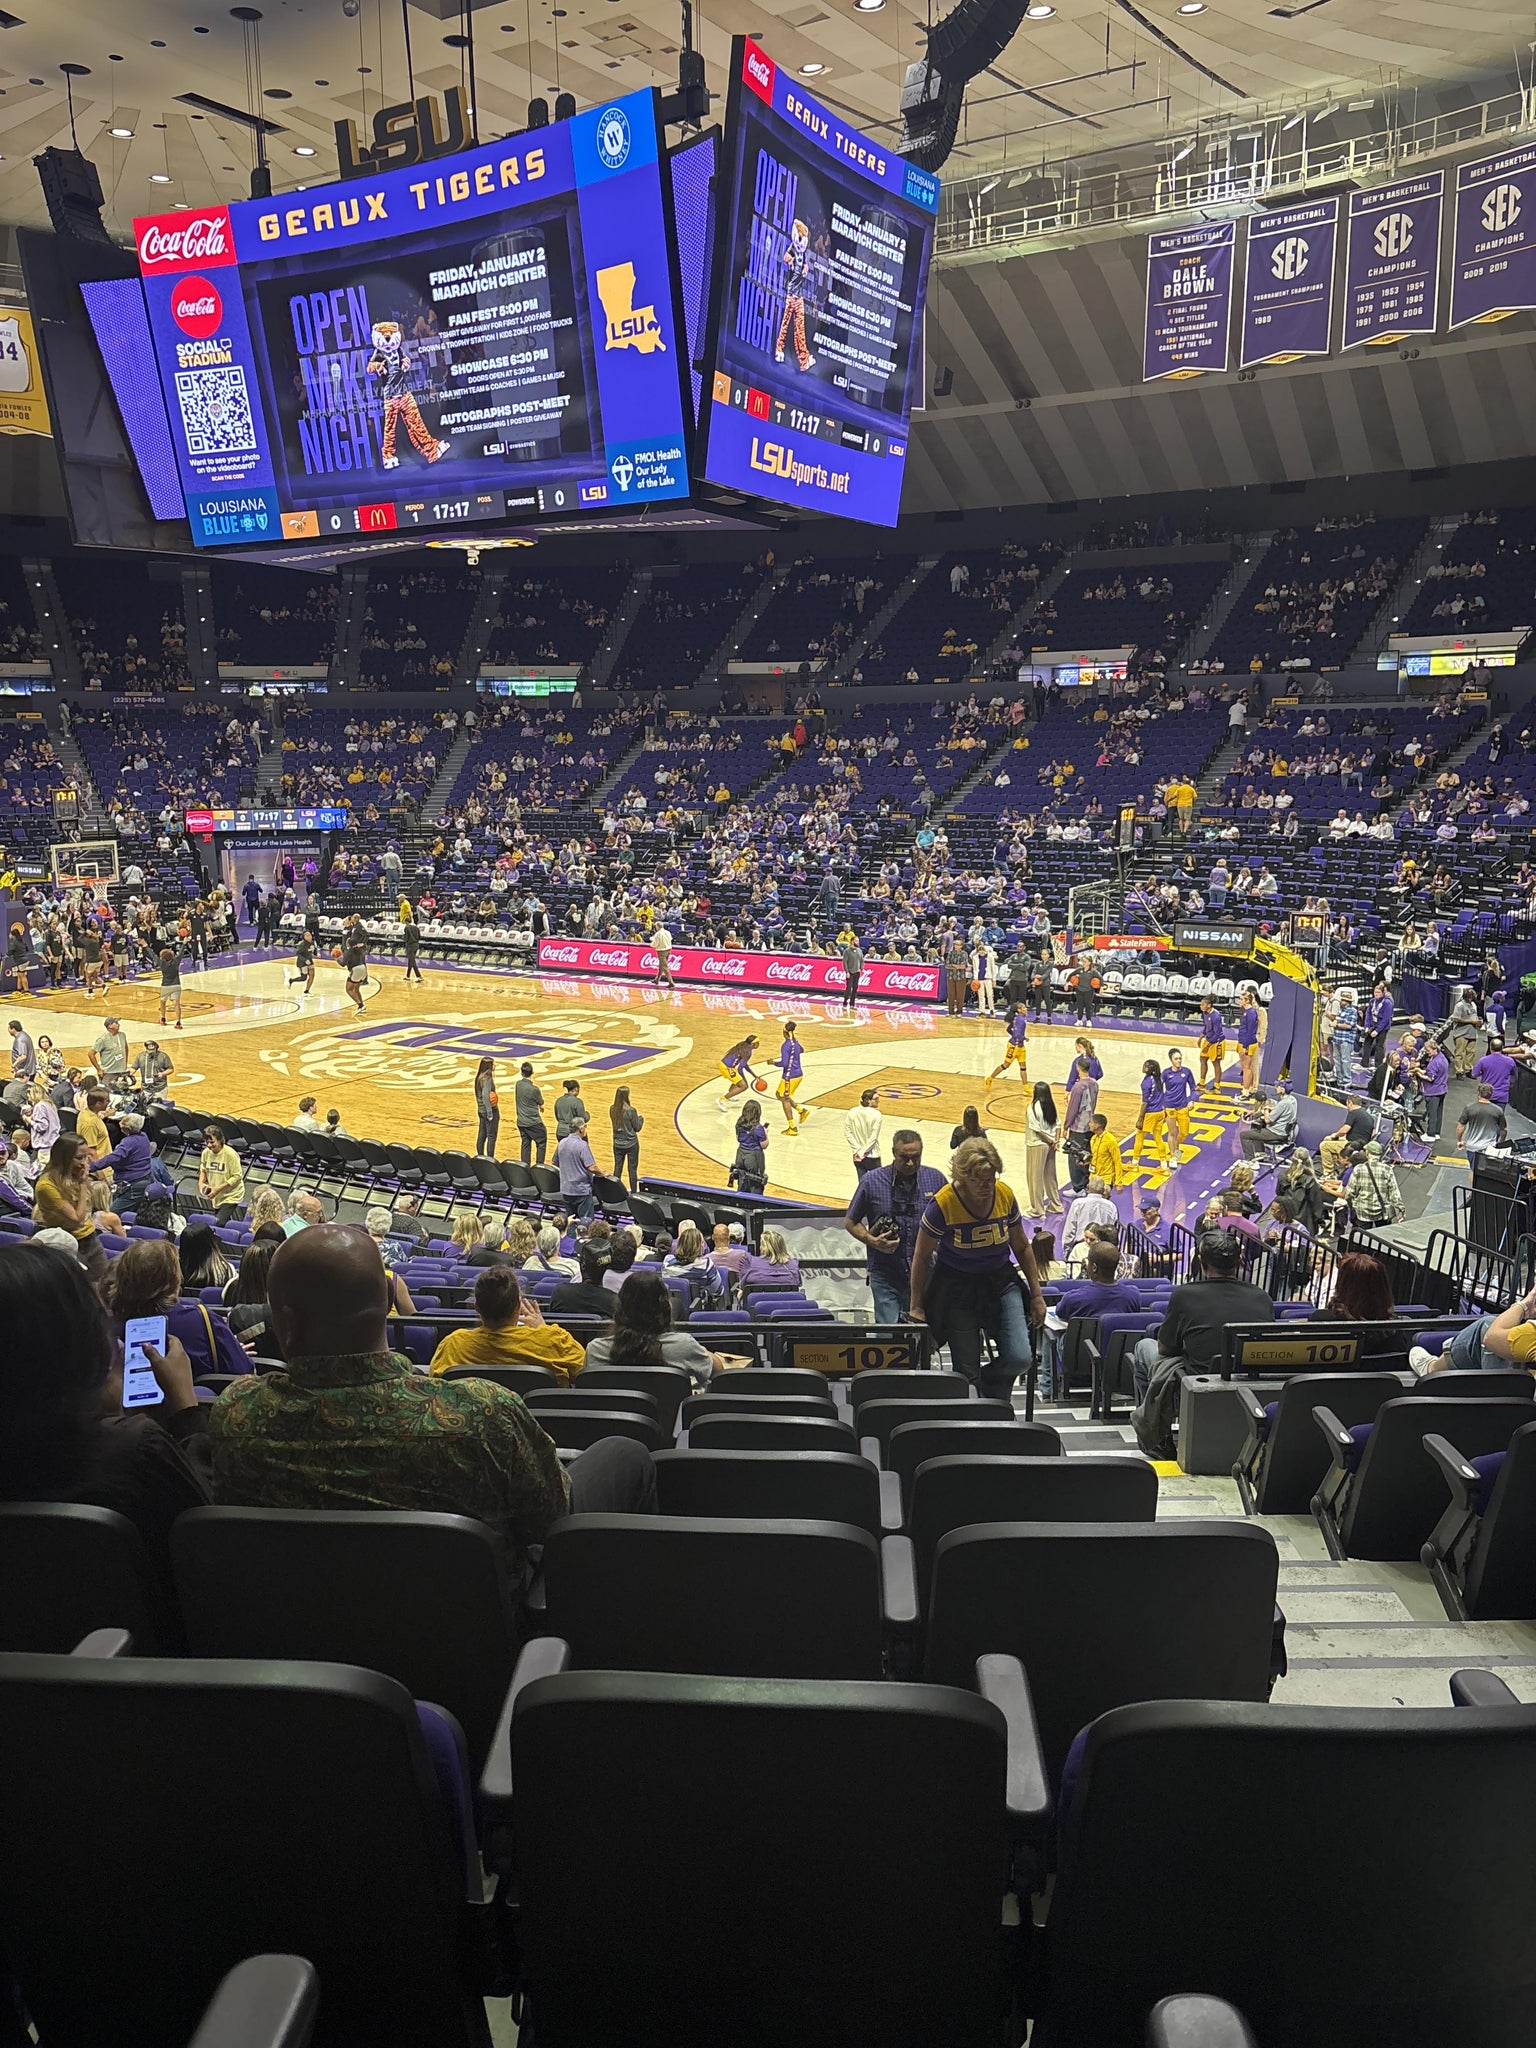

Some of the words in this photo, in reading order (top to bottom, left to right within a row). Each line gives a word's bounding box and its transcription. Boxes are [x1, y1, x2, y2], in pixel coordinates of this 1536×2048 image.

[334, 85, 472, 180] LSU
[599, 111, 626, 138] HANCOCK
[786, 94, 828, 140] GEAUX
[835, 131, 886, 176] TIGERS
[601, 138, 628, 168] WHITNEY
[1470, 166, 1492, 178] MEN'S
[1495, 151, 1536, 170] BASKETBAL
[907, 170, 935, 191] LOUISIANA
[258, 192, 388, 241] GEAUX
[409, 148, 546, 210] TIGERS
[754, 148, 798, 234] OPEN
[906, 183, 921, 199] BLUE
[1362, 193, 1384, 205] MEN'S
[1386, 182, 1430, 199] BASKETBALL
[1481, 184, 1522, 231] SEC
[1261, 218, 1281, 228] MEN'S
[1284, 208, 1325, 223] BASKETBALL
[141, 217, 228, 264] Coca-Cola
[1161, 237, 1181, 247] MEN'S
[1183, 231, 1223, 244] BASKETBALL
[1374, 213, 1414, 257] SEC
[1475, 232, 1524, 253] CHAMPIONS
[429, 264, 478, 286] FRIDAY,
[479, 250, 535, 275] JANUARY
[537, 247, 545, 261] 2
[1180, 256, 1201, 265] COACH
[1271, 237, 1309, 280] SEC
[1173, 265, 1207, 283] DALE
[1368, 259, 1416, 277] CHAMPIONS
[1464, 268, 1483, 279] 2009
[1490, 261, 1508, 273] 2019
[433, 276, 498, 301] MARAVICH
[499, 265, 546, 287] CENTER
[1164, 278, 1214, 299] BROWN
[1357, 292, 1374, 302] 1935
[1382, 286, 1399, 297] 1953
[1407, 281, 1424, 291] 1954
[1254, 290, 1289, 301] TOURNAMENT
[1291, 284, 1323, 294] CHAMPIONS
[177, 297, 215, 317] Coca-Cola
[449, 314, 470, 327] FAN
[472, 308, 498, 322] FEST
[500, 303, 523, 316] 5:00
[524, 299, 538, 312] PM
[1190, 304, 1207, 312] FOURS
[1357, 305, 1373, 315] 1979
[289, 285, 374, 354] OPEN
[439, 330, 460, 339] TSHIRT
[461, 323, 490, 336] GIVEAWAY
[491, 321, 502, 330] FOR
[503, 319, 519, 328] FIRST
[520, 315, 535, 326] 1,000
[536, 311, 551, 321] FANS
[1186, 314, 1204, 322] TITLES
[1379, 311, 1399, 322] 2000
[418, 343, 440, 353] CROWN
[447, 338, 470, 349] TROPHY
[470, 332, 495, 344] STATION
[500, 329, 513, 339] KIDS
[514, 326, 529, 337] ZONE
[533, 323, 549, 333] FOOD
[550, 317, 573, 329] TRUCKS
[611, 316, 647, 340] LSU
[1178, 321, 1218, 332] TOURNAMENTS
[1179, 333, 1205, 342] NATIONAL
[176, 340, 221, 356] SOCIAL
[1159, 343, 1177, 351] COACH
[1184, 351, 1198, 359] WINS
[179, 351, 232, 368] STADIUM
[451, 356, 509, 376] SHOWCASE
[510, 352, 532, 365] 6:30
[534, 349, 549, 361] PM
[299, 349, 380, 414] MIKE
[468, 375, 488, 383] DOORS
[489, 372, 505, 380] OPEN
[506, 370, 512, 378] AT
[526, 366, 535, 374] PM
[453, 388, 468, 397] WITH
[468, 386, 485, 394] TEAM
[491, 381, 517, 391] COACHES
[522, 376, 541, 385] GAMES
[548, 371, 565, 380] MUSIC
[440, 405, 511, 426] AUTOGRAPHS
[513, 395, 570, 413] POST-MEET
[777, 412, 780, 423] 1
[467, 424, 482, 432] TEAM
[482, 421, 506, 431] SIGNING
[510, 416, 533, 426] POSTER
[534, 411, 562, 421] GIVEAWAY
[790, 409, 819, 435] 17:17
[298, 411, 385, 475] NIGHT
[483, 443, 504, 455] LSU
[873, 439, 880, 452] 0
[889, 444, 904, 456] LSU
[189, 457, 207, 466] Want
[227, 456, 241, 464] your
[242, 454, 260, 462] photo
[635, 451, 656, 464] FMOL
[657, 447, 681, 460] Health
[218, 462, 255, 472] videoboard?
[636, 466, 650, 476] Our
[651, 463, 668, 477] Lady
[750, 437, 849, 494] LSUsports.net
[637, 479, 648, 489] of
[649, 477, 660, 486] the
[659, 476, 675, 486] Lake
[555, 490, 564, 506] 0
[581, 486, 607, 501] LSU
[200, 498, 266, 516] LOUISIANA
[433, 501, 470, 519] 17:17
[203, 516, 239, 535] BLUE
[331, 515, 341, 530] 0
[412, 512, 419, 522] 1
[221, 820, 228, 830] 0
[254, 812, 279, 821] 17:17
[306, 819, 313, 828] 0
[1183, 930, 1243, 942] NISSAN
[541, 945, 581, 963] Coca-Cola
[590, 949, 630, 966] Coca-Cola
[702, 958, 747, 976] Coca-Cola
[767, 962, 814, 981] Coca-Cola
[885, 971, 936, 992] Coca-Cola
[954, 1220, 1009, 1249] LSU
[800, 1354, 829, 1363] SECTION
[838, 1347, 910, 1369] 102
[1306, 1344, 1351, 1362] 101
